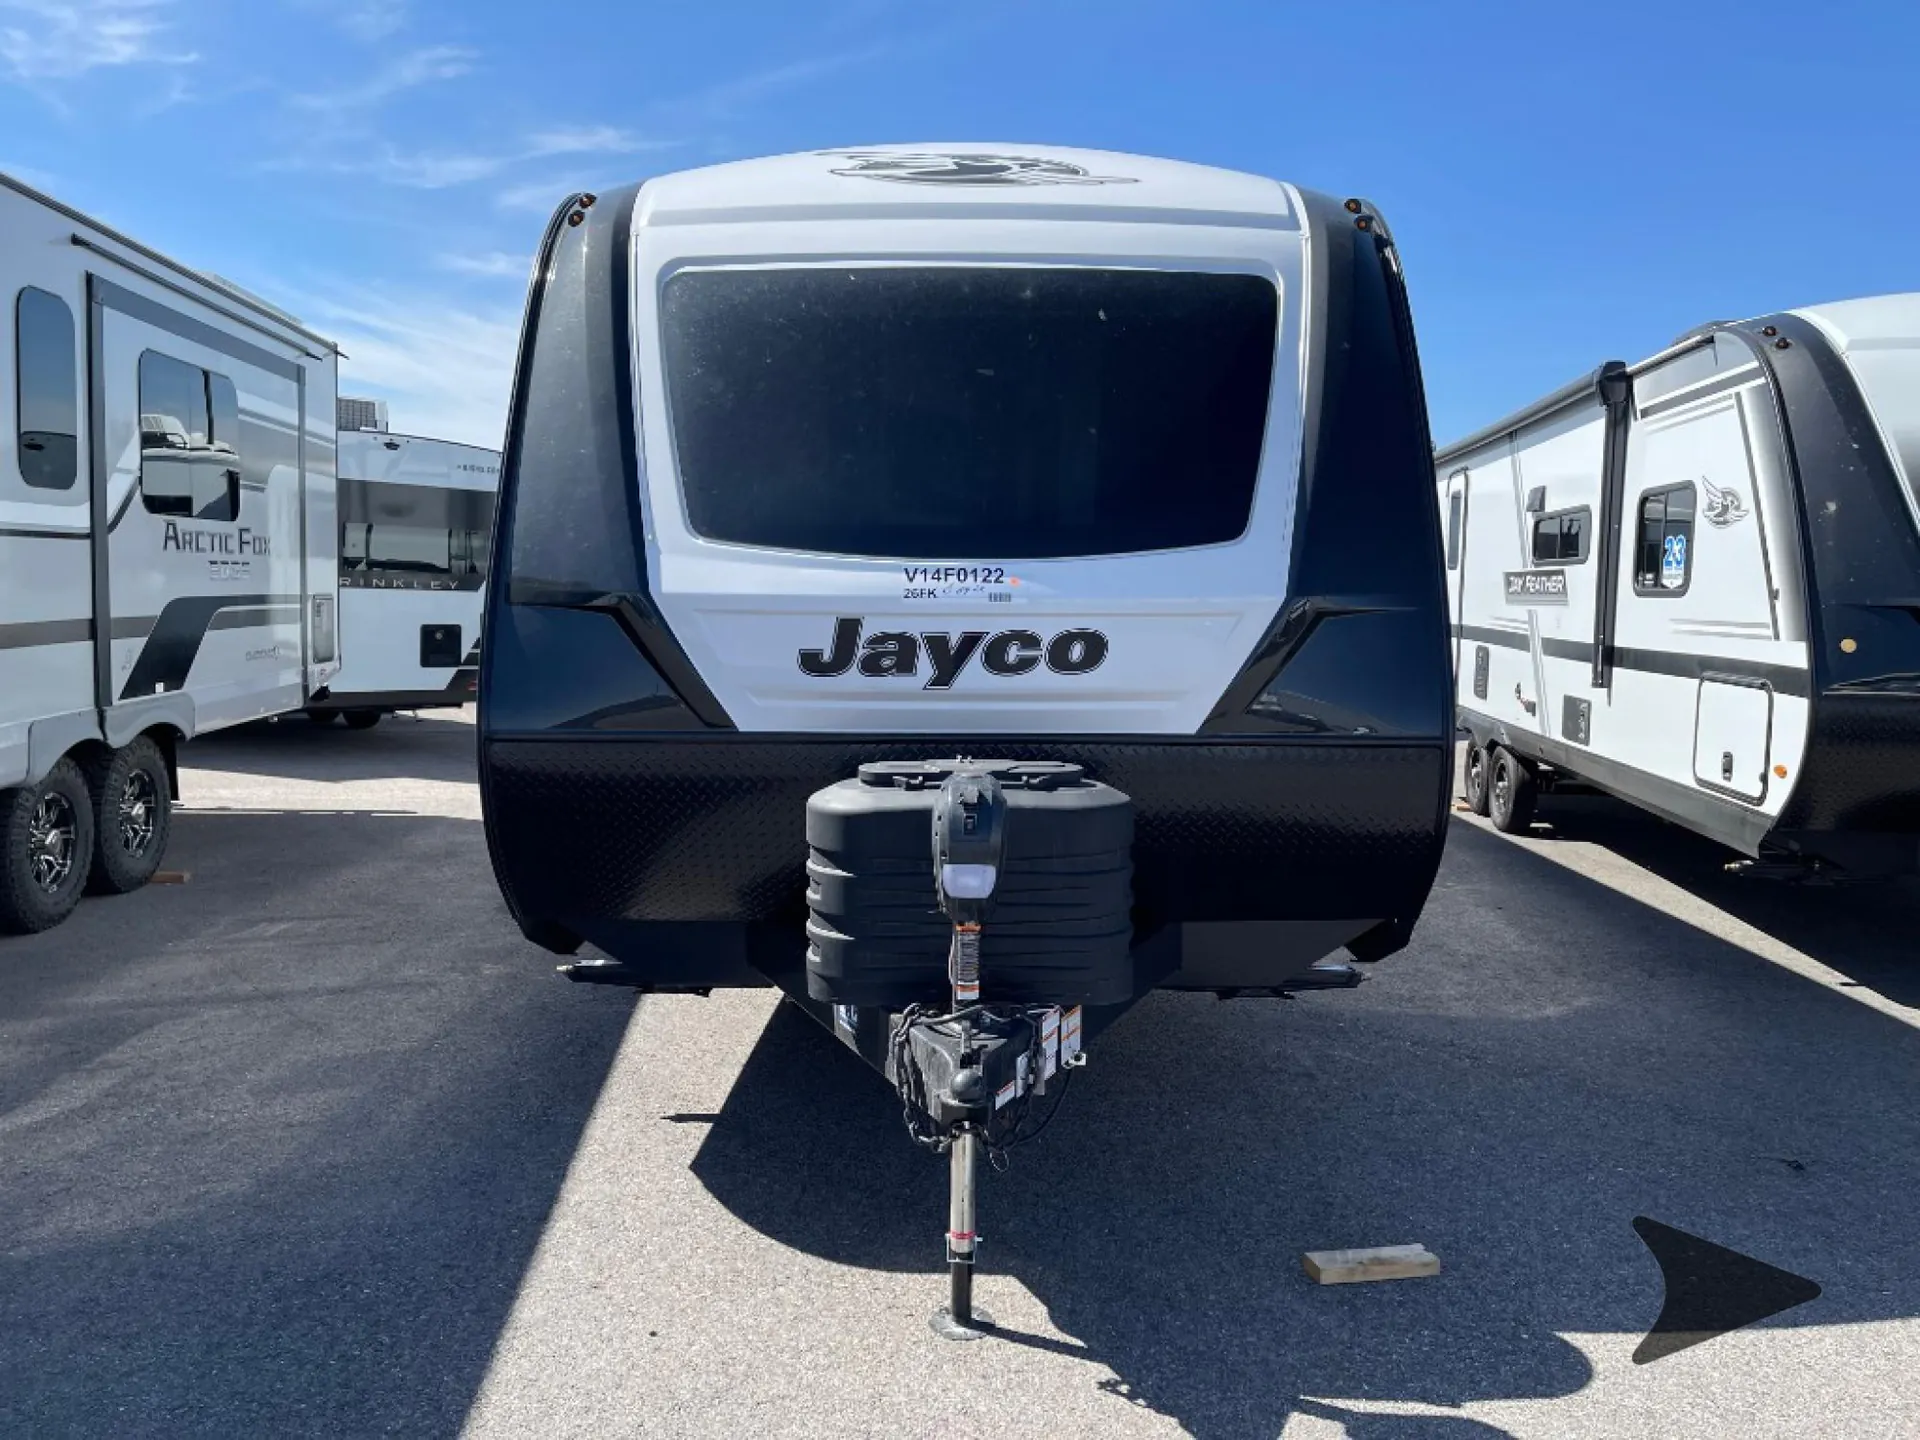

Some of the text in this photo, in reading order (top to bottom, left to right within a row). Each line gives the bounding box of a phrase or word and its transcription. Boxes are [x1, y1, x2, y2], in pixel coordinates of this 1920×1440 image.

[163, 520, 235, 553] ARCTIC
[1664, 534, 1686, 569] 23
[903, 567, 1004, 584] V14F0122
[1508, 574, 1564, 593] JAY FEATHER
[903, 588, 937, 599] 26FK
[797, 615, 1109, 690] Jayco
